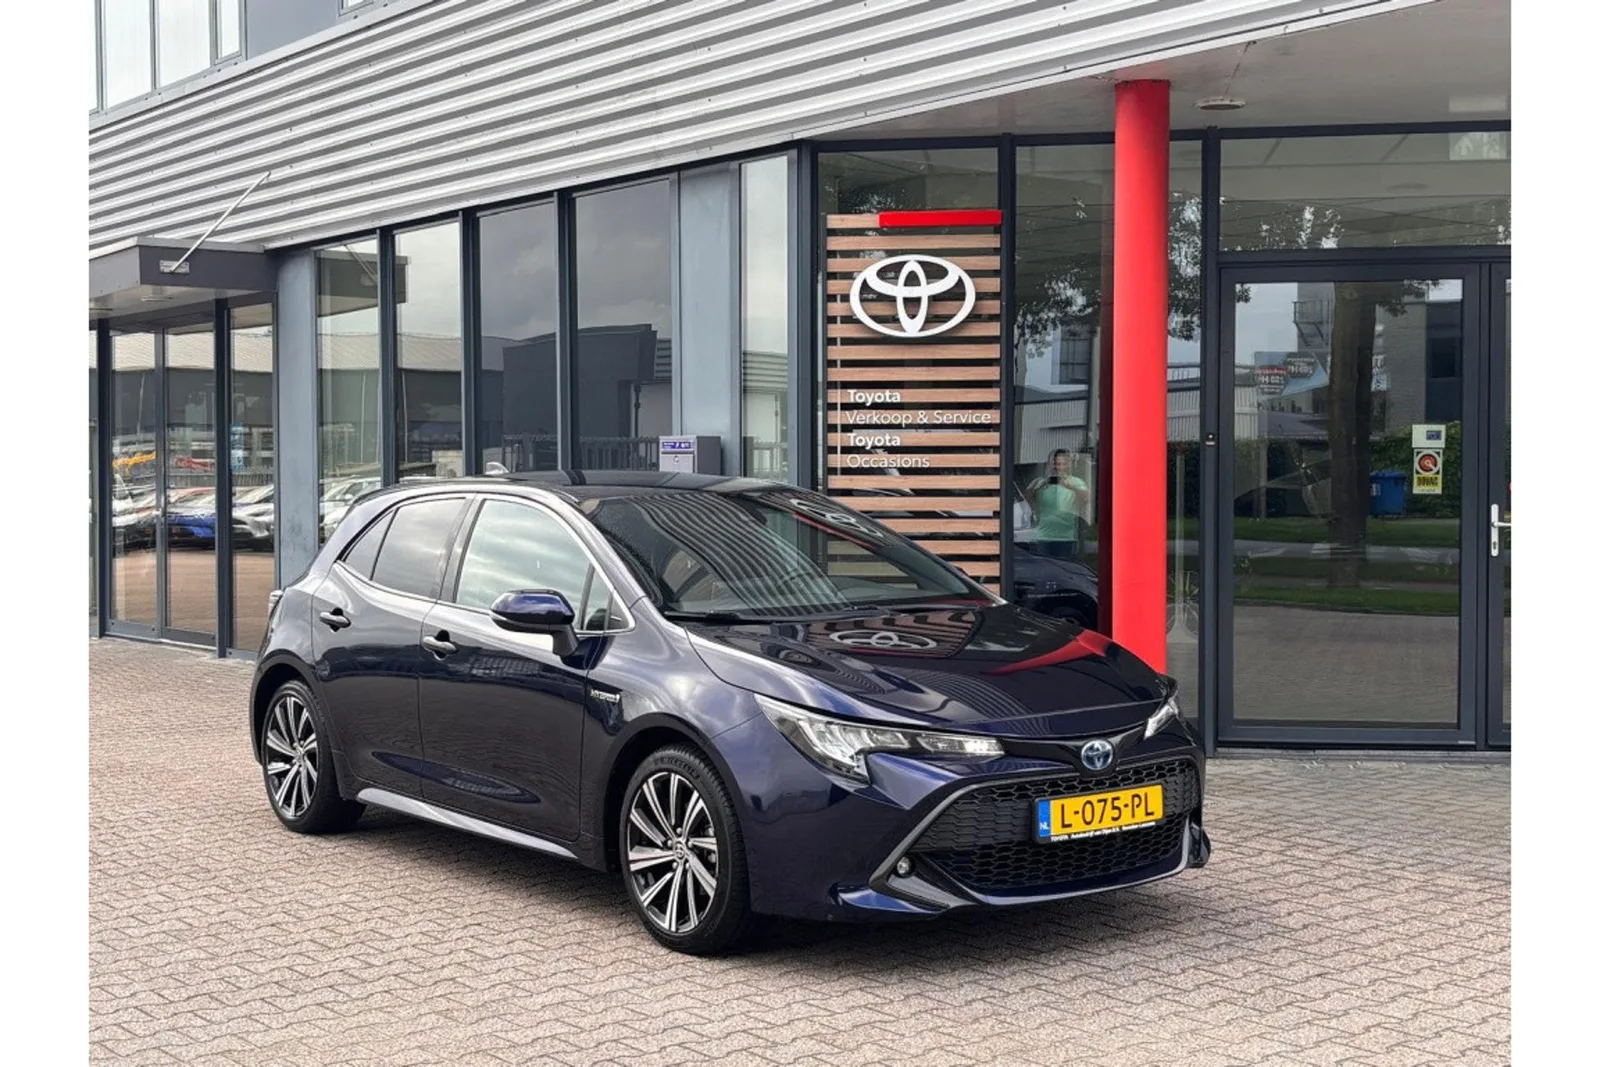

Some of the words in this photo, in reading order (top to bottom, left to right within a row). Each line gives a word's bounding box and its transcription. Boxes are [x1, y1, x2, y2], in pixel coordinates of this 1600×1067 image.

[847, 389, 901, 406] Toyota
[846, 410, 912, 427] Verkoop
[917, 410, 929, 424] &
[933, 410, 991, 424] Service
[847, 433, 901, 449] Toyota
[846, 454, 930, 468] Occasions
[1039, 821, 1050, 830] NL
[1061, 792, 1155, 829] L-075-PL
